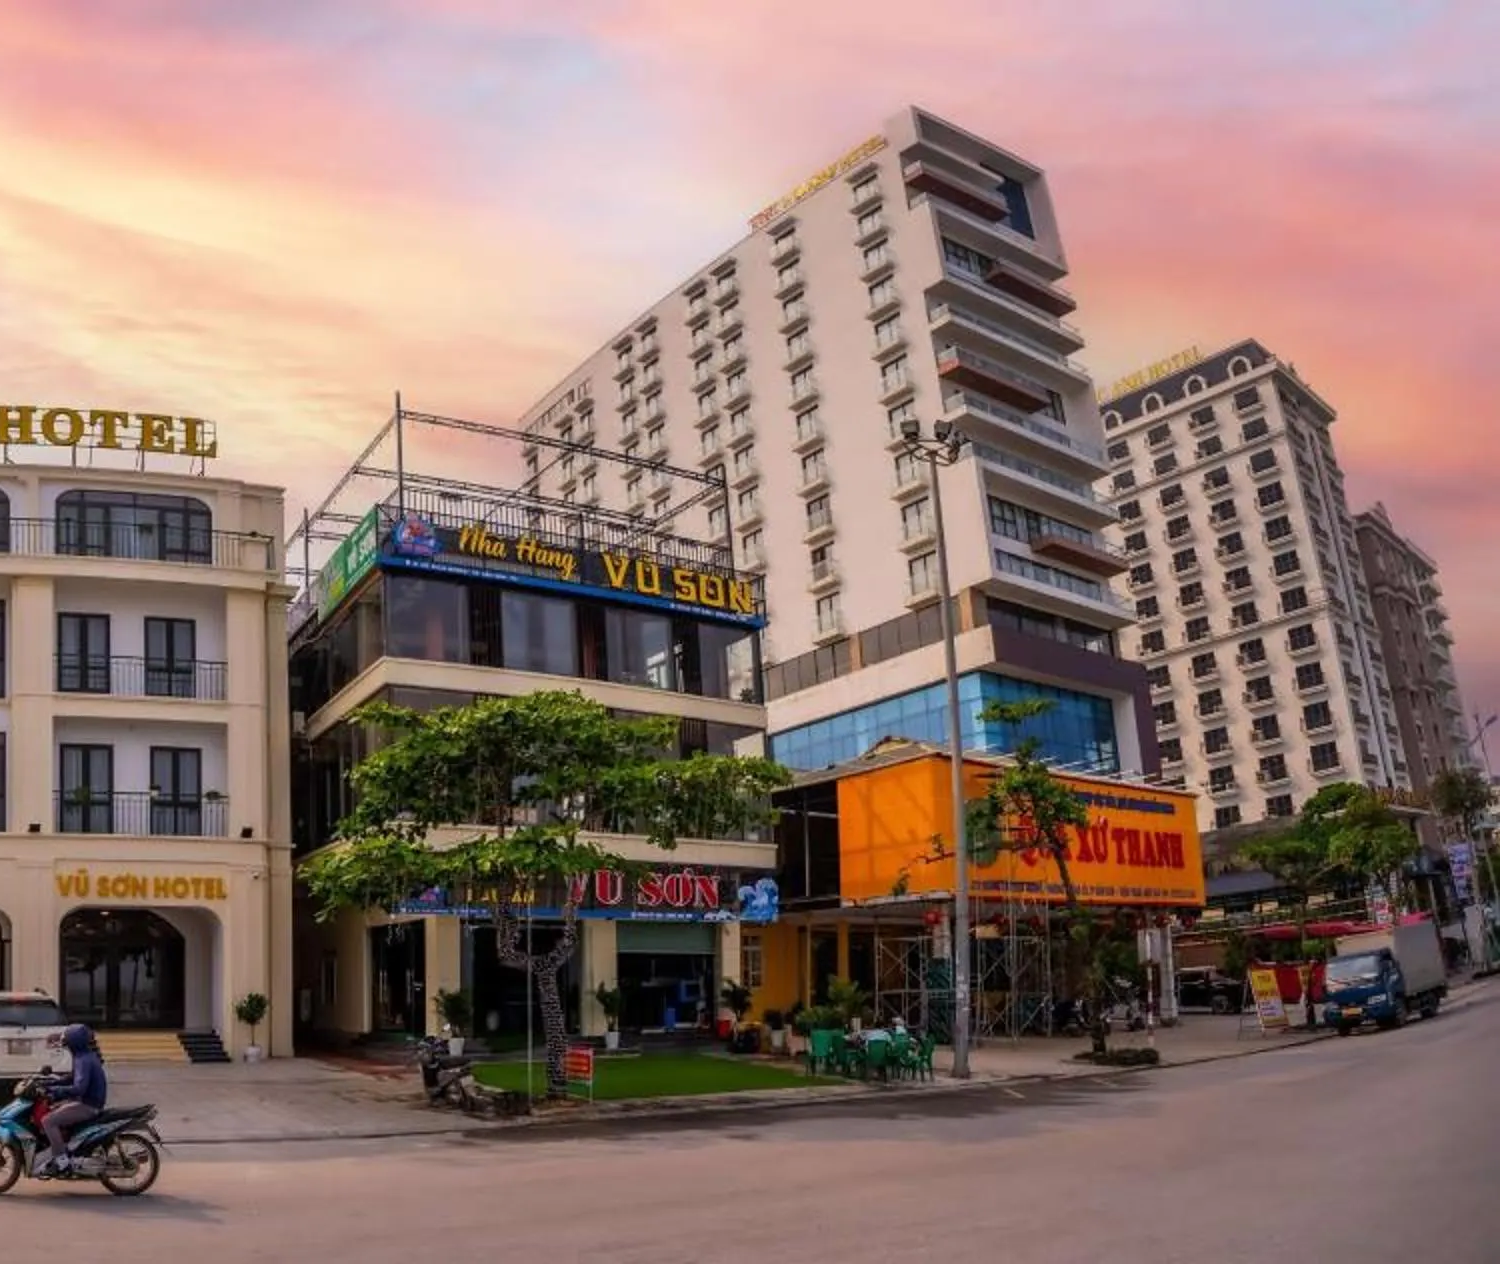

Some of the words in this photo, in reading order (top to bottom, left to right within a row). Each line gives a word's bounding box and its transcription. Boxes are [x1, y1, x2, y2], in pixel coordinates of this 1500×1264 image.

[1111, 826, 1185, 868] THANH
[56, 867, 90, 897] VŨ
[97, 871, 148, 898] SƠN
[154, 875, 228, 900] HOTEL
[637, 867, 720, 908] SƠN
